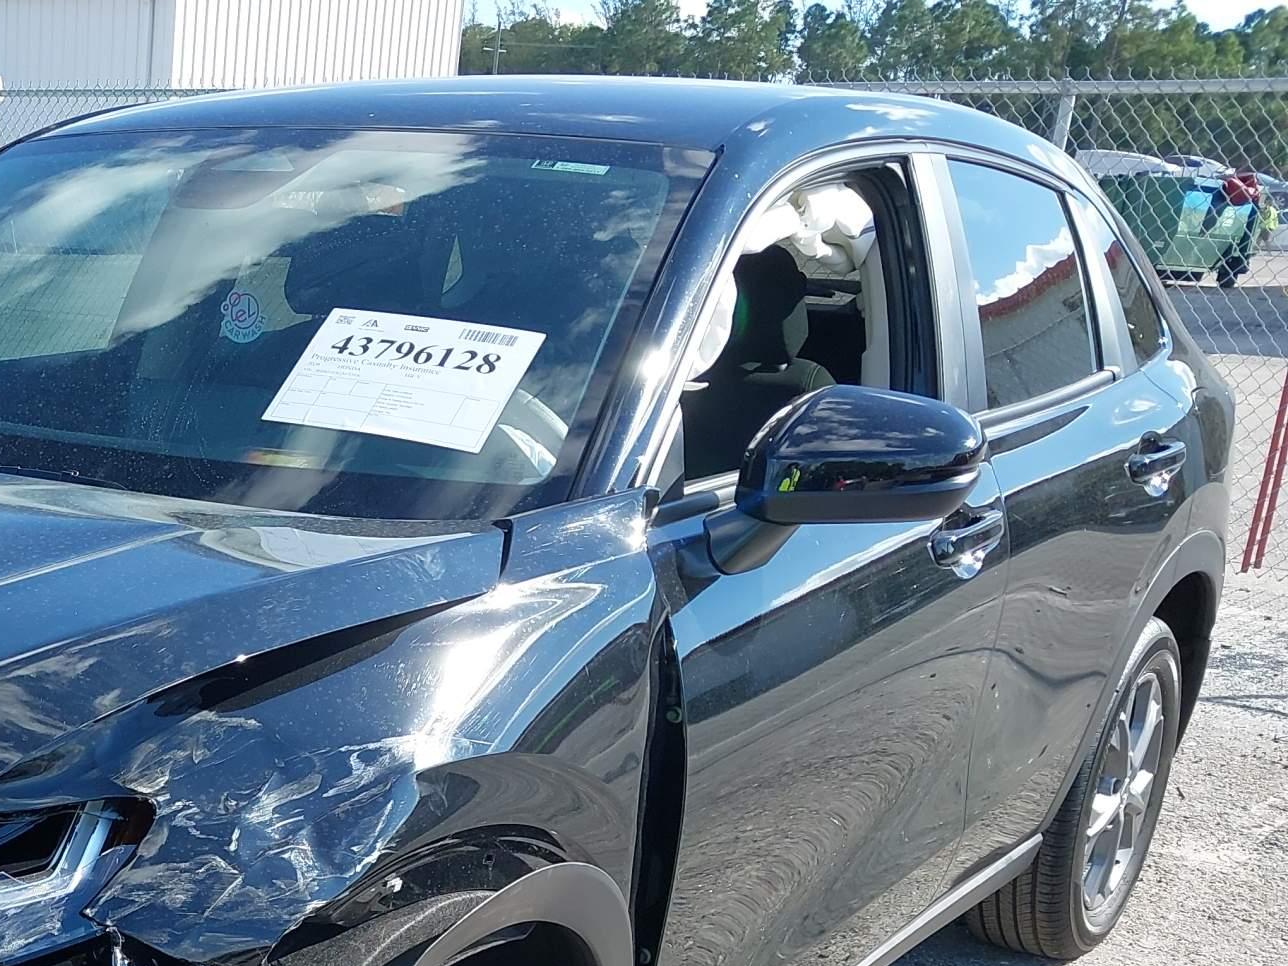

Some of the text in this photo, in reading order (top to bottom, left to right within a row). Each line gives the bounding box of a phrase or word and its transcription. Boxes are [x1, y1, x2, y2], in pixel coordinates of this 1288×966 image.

[311, 353, 360, 365] Progressive
[361, 358, 399, 370] Casualty
[399, 362, 442, 375] Insurance
[330, 334, 502, 375] 43796128
